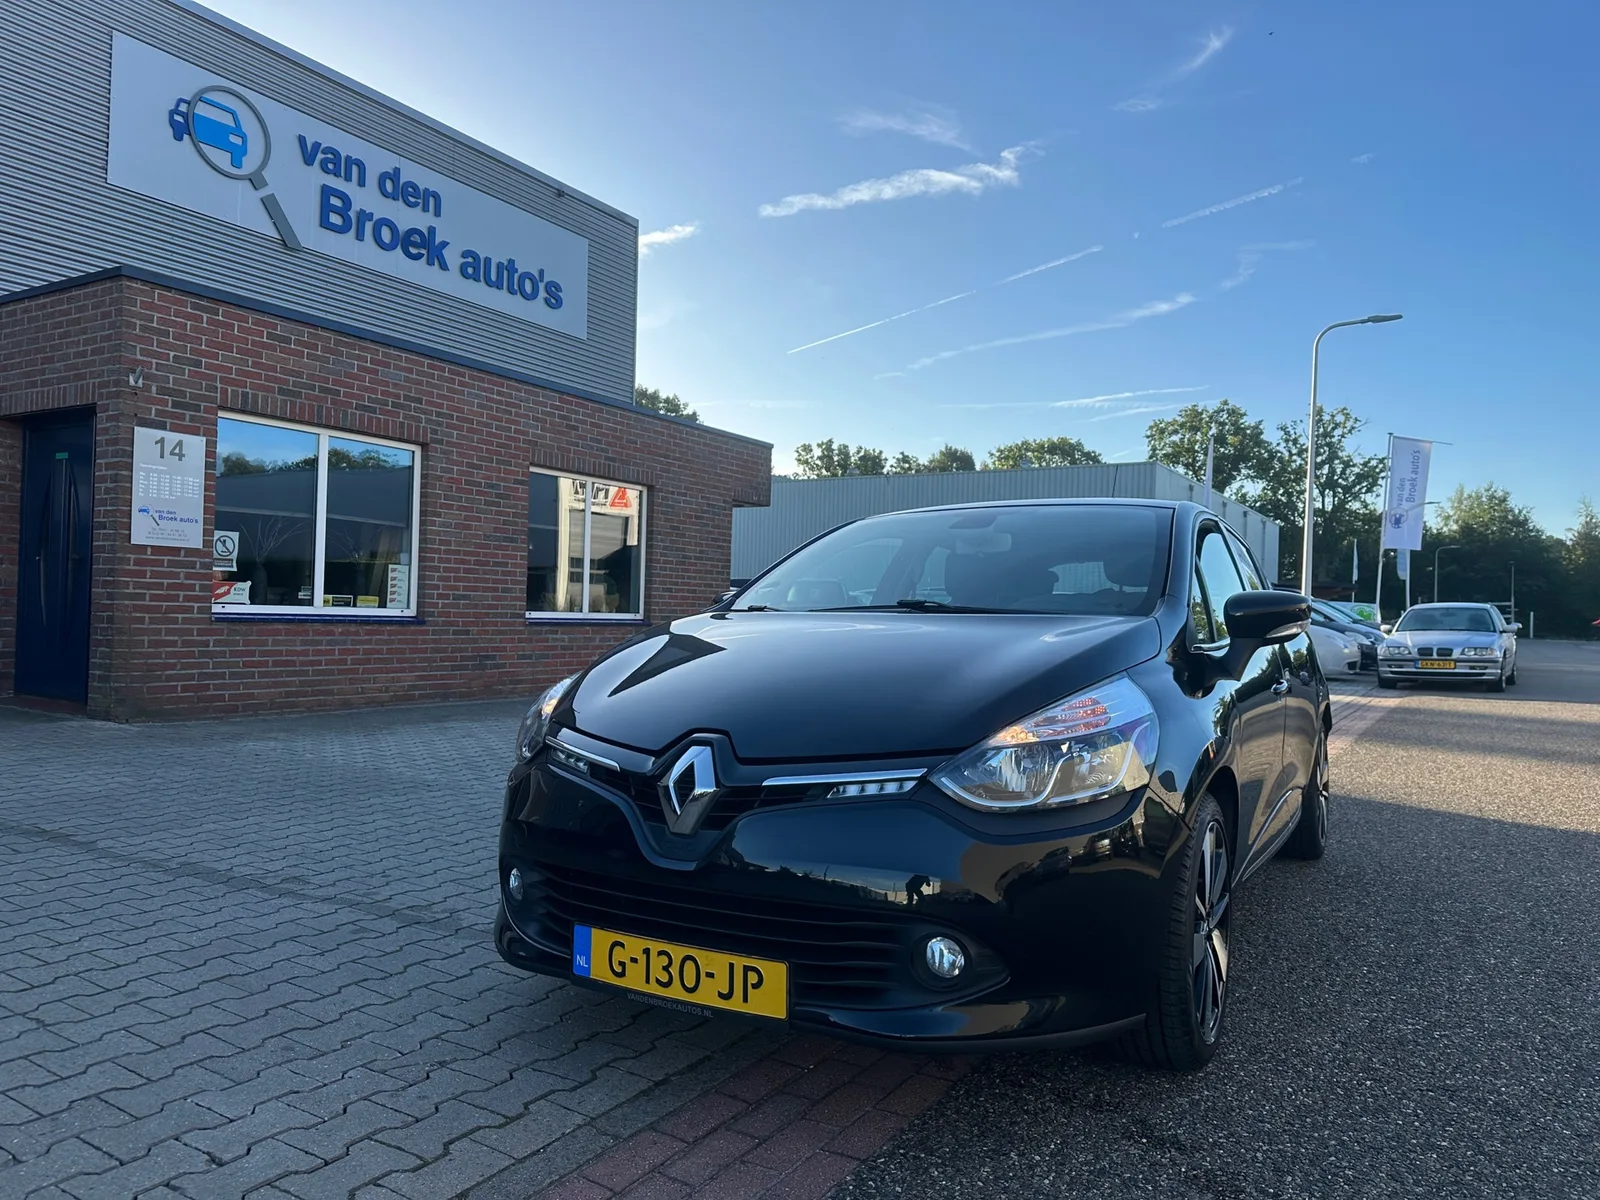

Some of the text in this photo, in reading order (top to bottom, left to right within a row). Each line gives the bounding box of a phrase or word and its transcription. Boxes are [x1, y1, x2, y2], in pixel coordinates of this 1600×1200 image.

[298, 133, 442, 218] van den
[319, 183, 564, 310] Broek auto's
[154, 436, 186, 462] 14
[1396, 477, 1406, 507] van den
[1404, 449, 1421, 503] Broek auto's
[158, 514, 178, 522] Broek
[576, 940, 764, 1004] NL G-130-JP
[626, 992, 714, 1018] VANDENBROEKAUTOS.NL
